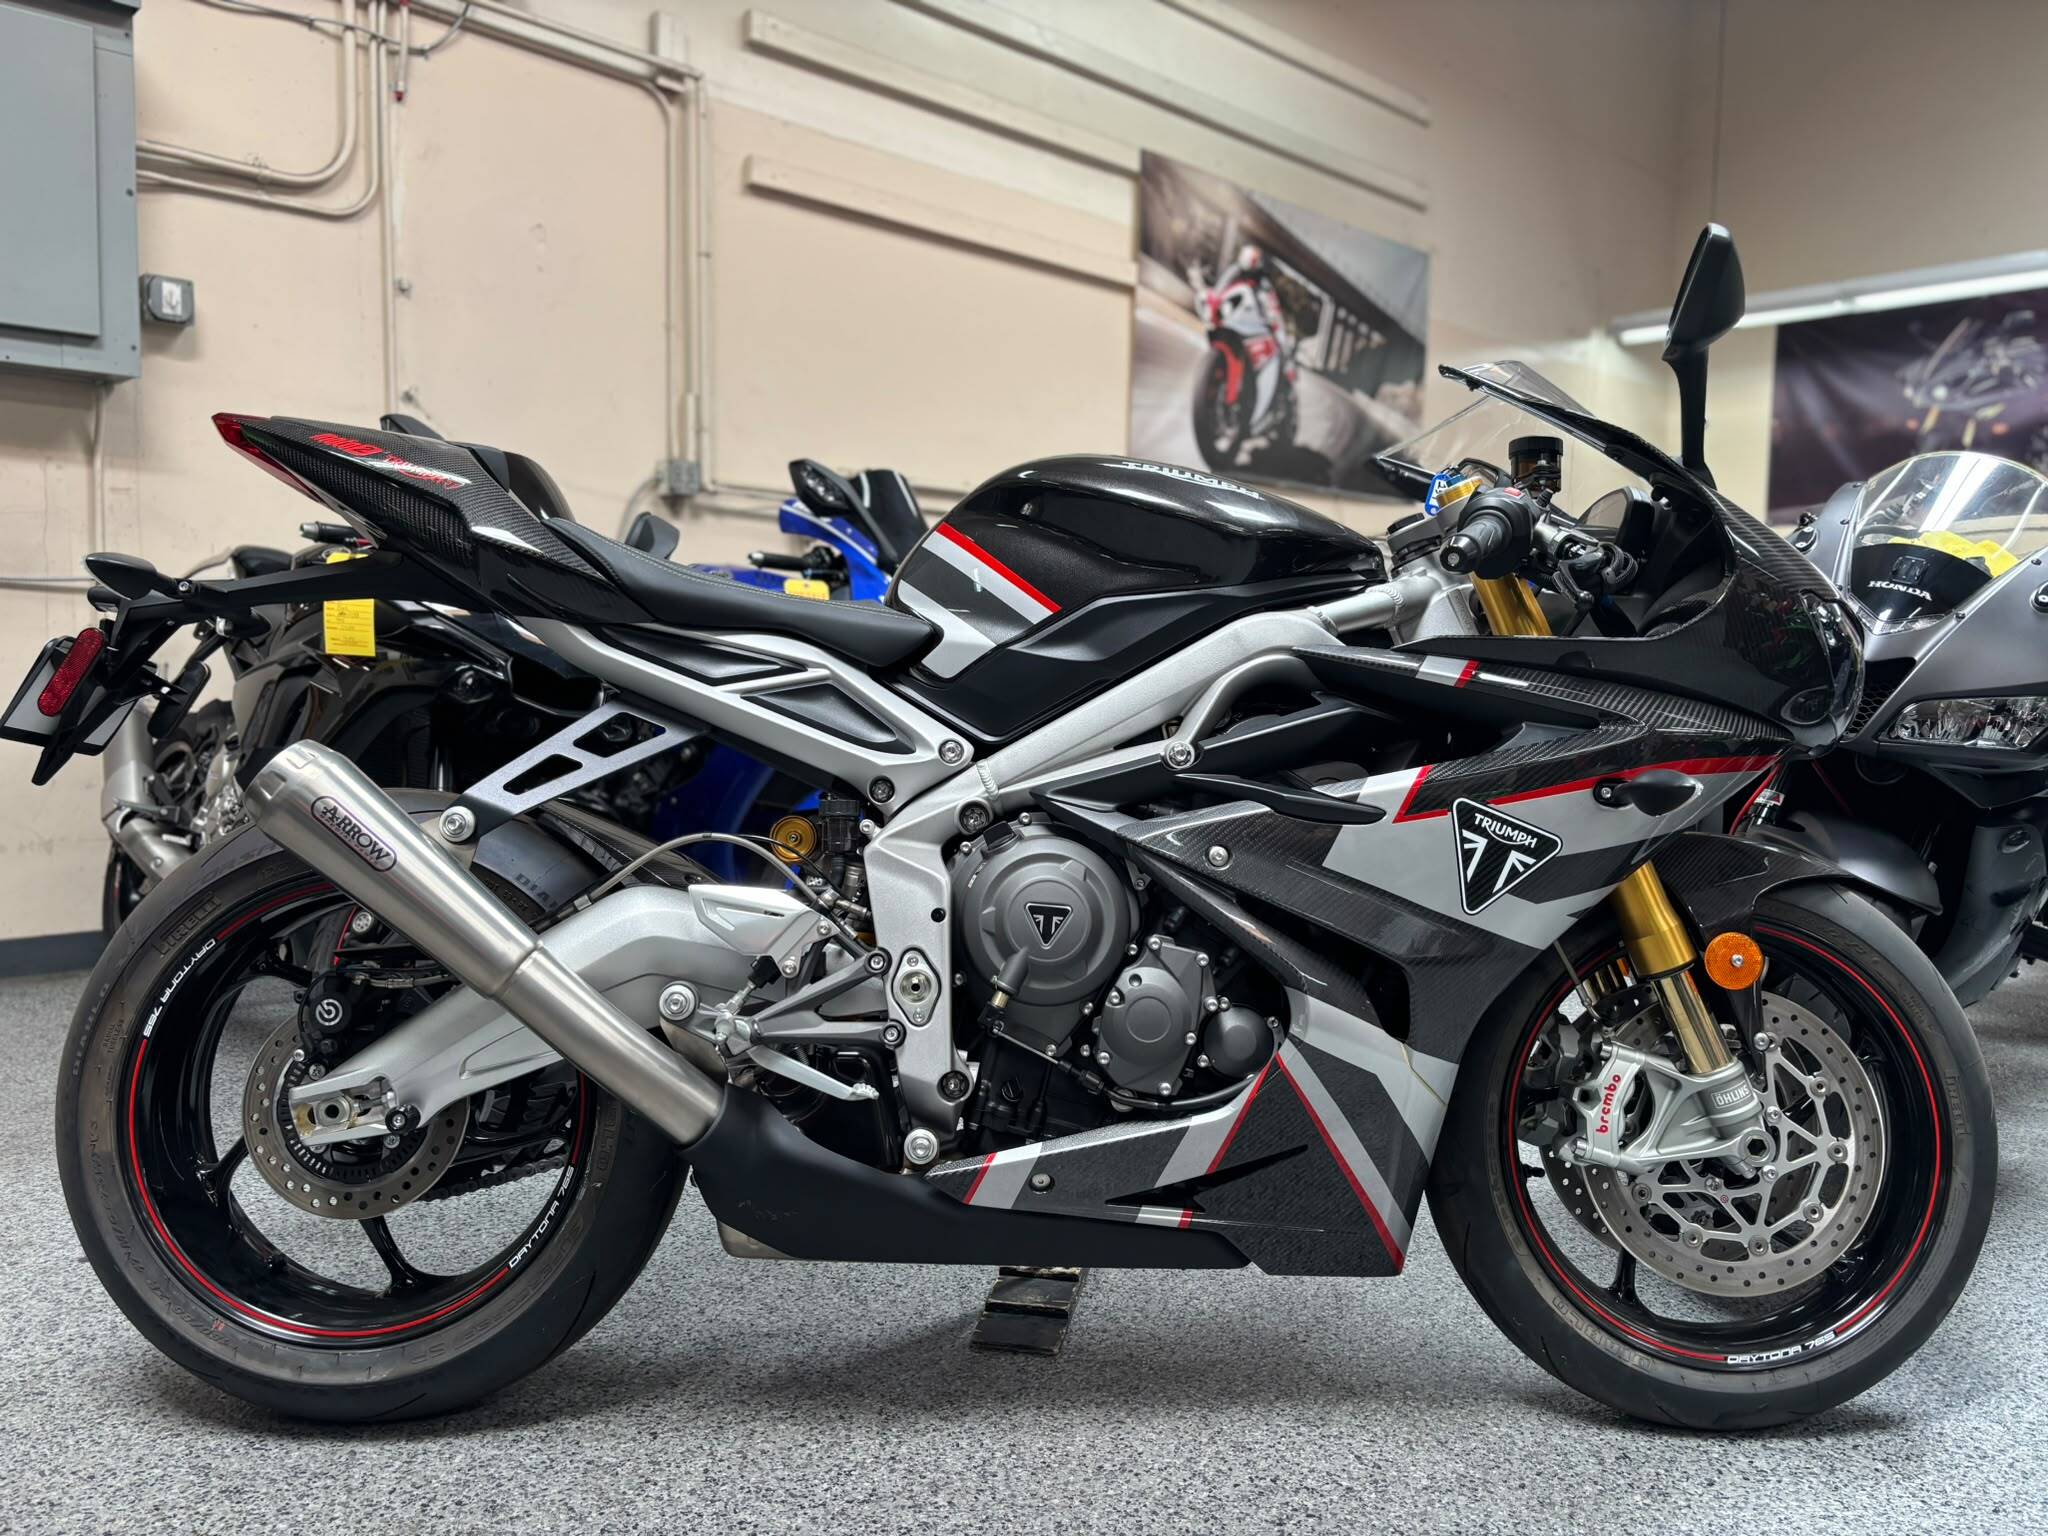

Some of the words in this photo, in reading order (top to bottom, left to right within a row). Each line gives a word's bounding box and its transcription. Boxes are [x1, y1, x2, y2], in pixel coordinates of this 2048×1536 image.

[1121, 461, 1266, 501] TRIUMPH
[1867, 580, 1933, 602] HONDA
[321, 805, 392, 861] ARROW
[1474, 812, 1539, 849] TRIUMPH
[151, 890, 222, 957] PIRELLI
[160, 938, 216, 1003] DAYTONA
[143, 1005, 163, 1037] 765
[1596, 1073, 1622, 1134] brembo
[508, 1199, 560, 1269] DAYTONA
[557, 1165, 575, 1197] 765
[1727, 1344, 1802, 1365] DAYTONA
[1804, 1330, 1836, 1350] 765
